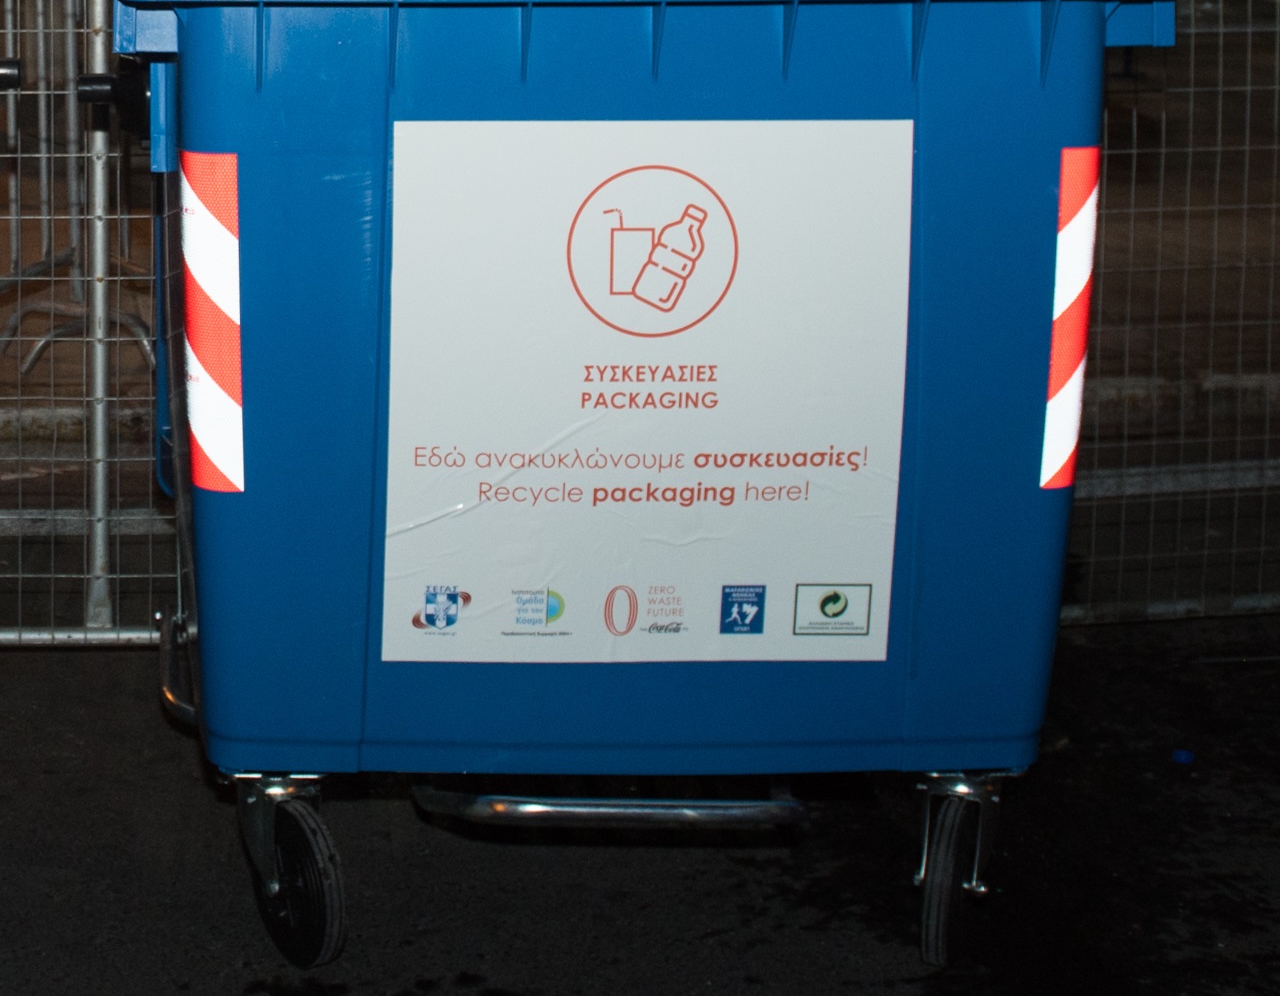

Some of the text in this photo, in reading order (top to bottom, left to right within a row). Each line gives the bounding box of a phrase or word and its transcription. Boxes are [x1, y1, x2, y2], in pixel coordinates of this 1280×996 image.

[583, 364, 718, 383] ΣΥΣΚΕΥΑΣΙΕΣ
[580, 391, 719, 410] PACKAGING
[413, 444, 870, 473] Εδώ ανακυκλώνουμε συσκευασίες!
[477, 480, 811, 508] Recycle packaging here!
[648, 585, 676, 595] ZERO
[647, 596, 682, 606] WASTE
[647, 607, 684, 617] FUTURE
